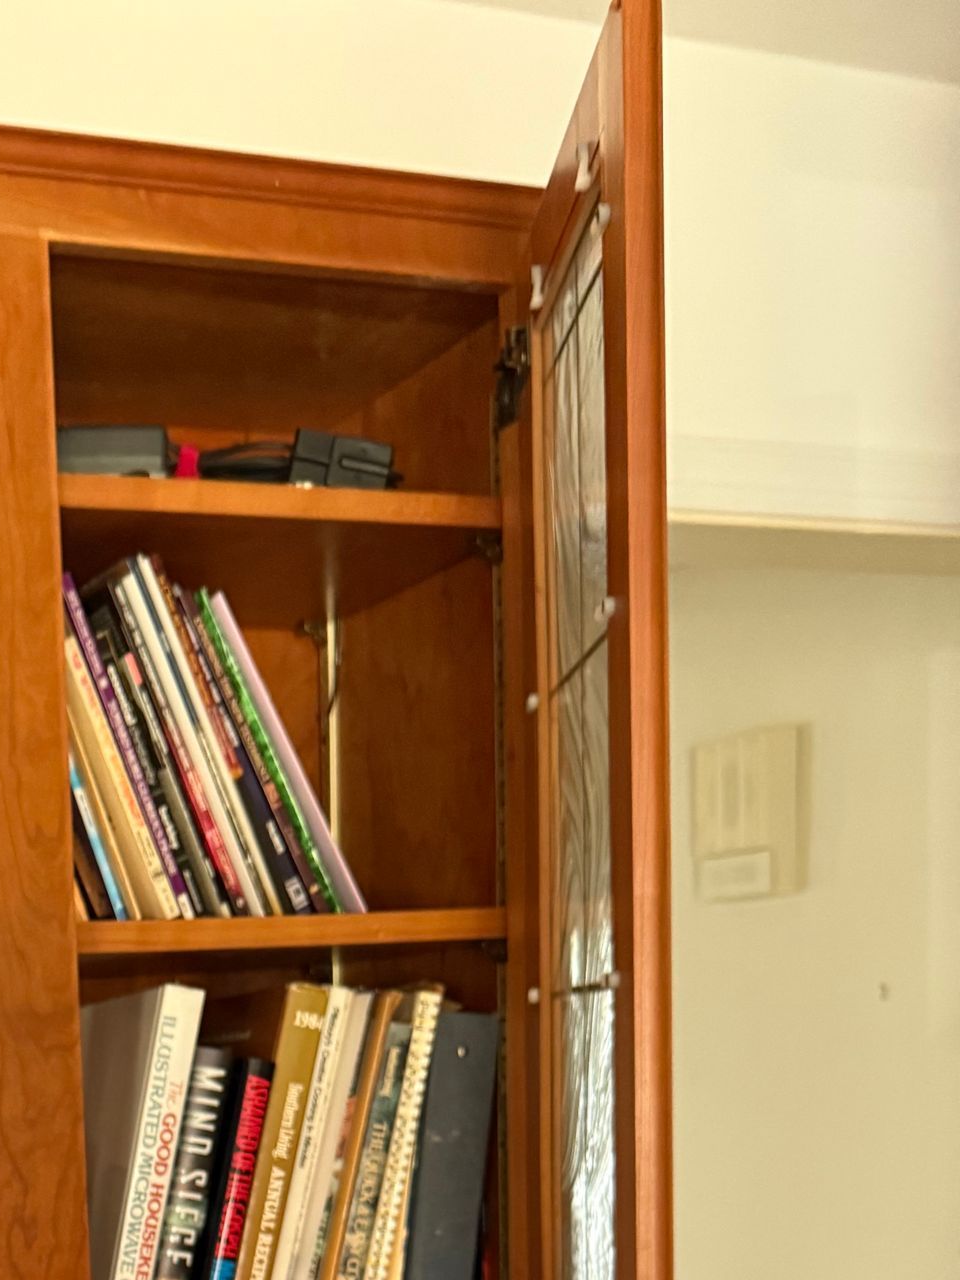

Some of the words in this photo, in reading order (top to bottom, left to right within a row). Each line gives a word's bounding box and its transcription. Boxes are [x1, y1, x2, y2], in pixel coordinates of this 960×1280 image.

[140, 1014, 177, 1149] ILLUSTRATED
[166, 1080, 182, 1110] The
[180, 1064, 228, 1157] MIND
[234, 1073, 270, 1152] ASHAMED
[280, 1081, 304, 1129] Southern
[152, 1111, 177, 1177] GOOD
[230, 1150, 256, 1172] OF
[271, 1127, 294, 1161] Living
[367, 1119, 388, 1153] THE
[119, 1151, 153, 1274] MICROWAVE
[168, 1164, 208, 1269] SIEGE
[224, 1170, 252, 1203] THE
[259, 1165, 286, 1232] ANNUAL
[213, 1201, 246, 1260] GOSPEL
